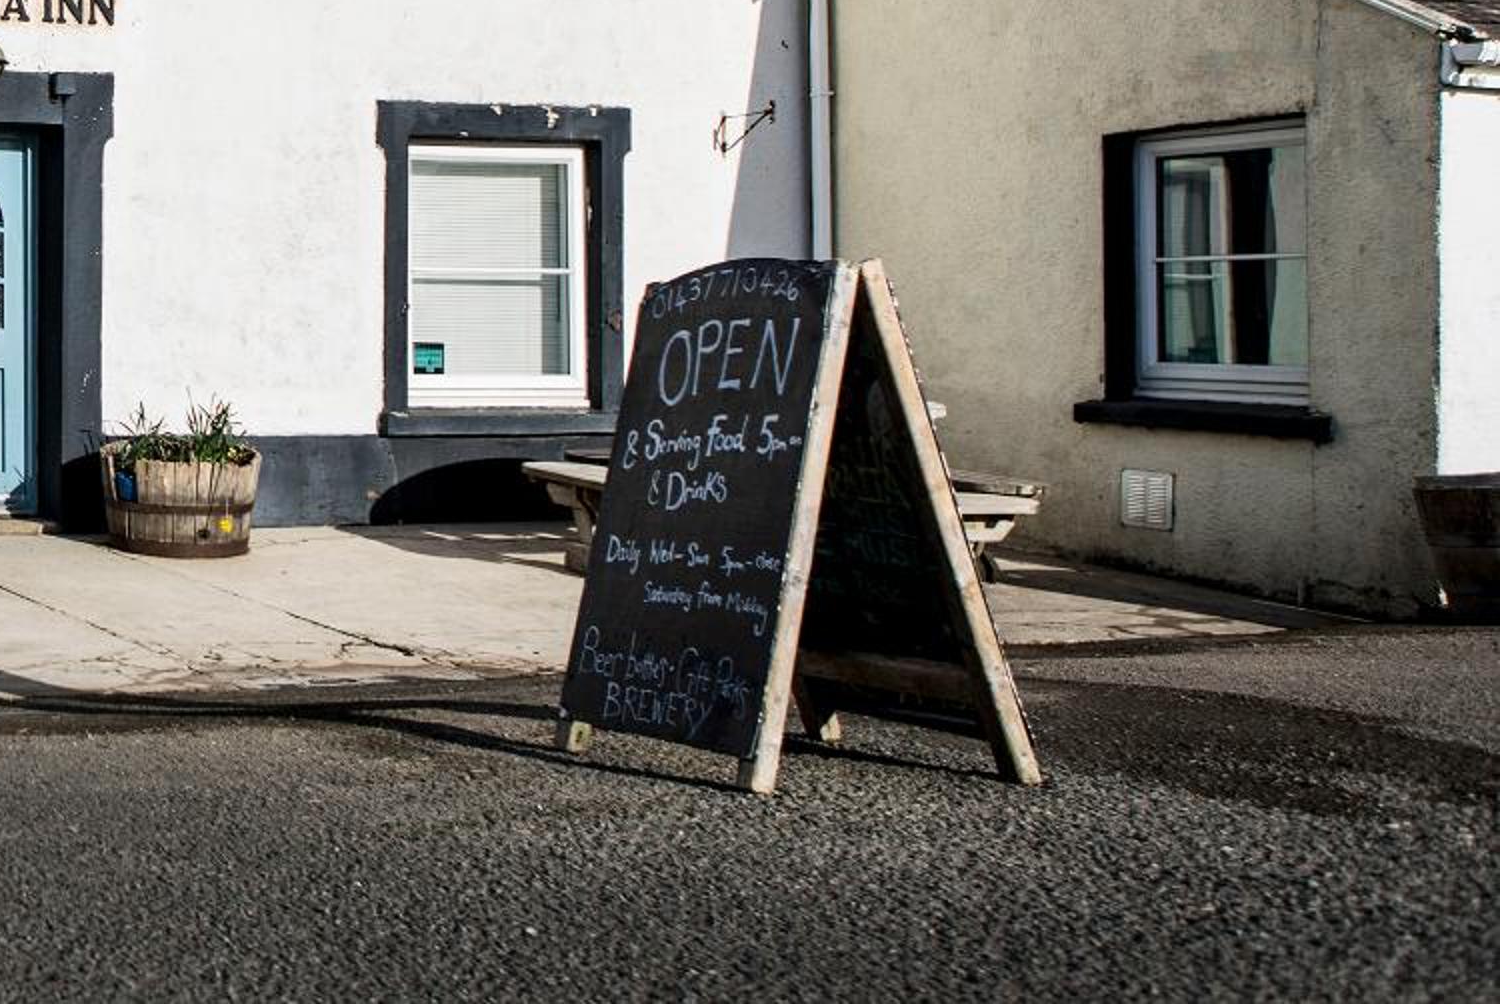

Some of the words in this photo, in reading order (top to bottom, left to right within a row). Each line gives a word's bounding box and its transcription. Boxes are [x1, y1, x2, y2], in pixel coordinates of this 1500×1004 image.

[658, 316, 801, 407] OPEN
[645, 419, 702, 471] Serving
[705, 413, 750, 457] Food
[605, 534, 641, 576] Daily
[603, 680, 714, 741] BREWERY
